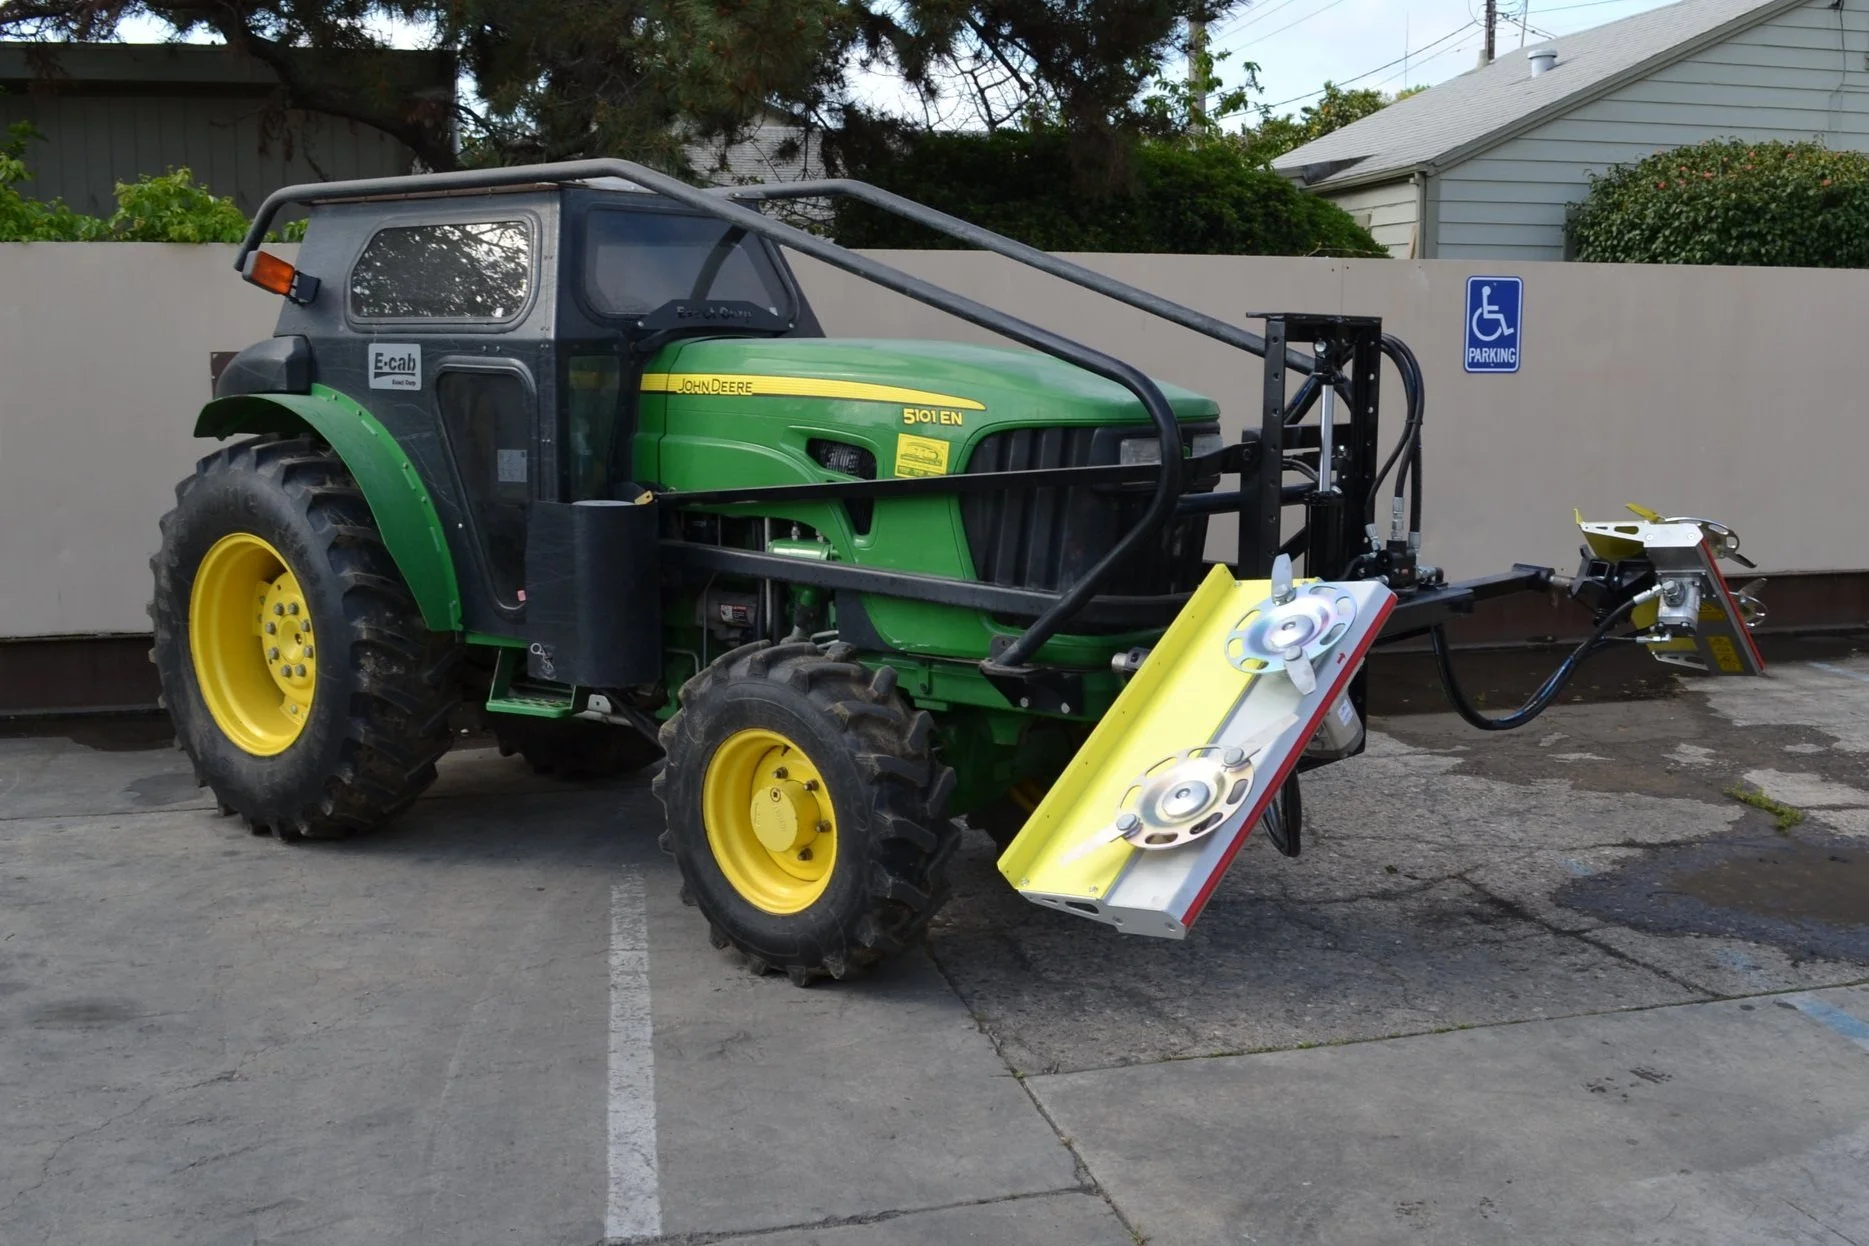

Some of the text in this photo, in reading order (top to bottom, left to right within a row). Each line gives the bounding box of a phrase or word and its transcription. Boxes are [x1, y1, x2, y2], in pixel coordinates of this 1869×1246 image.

[1468, 347, 1516, 363] PARKING
[678, 378, 753, 394] JOHN DEERE
